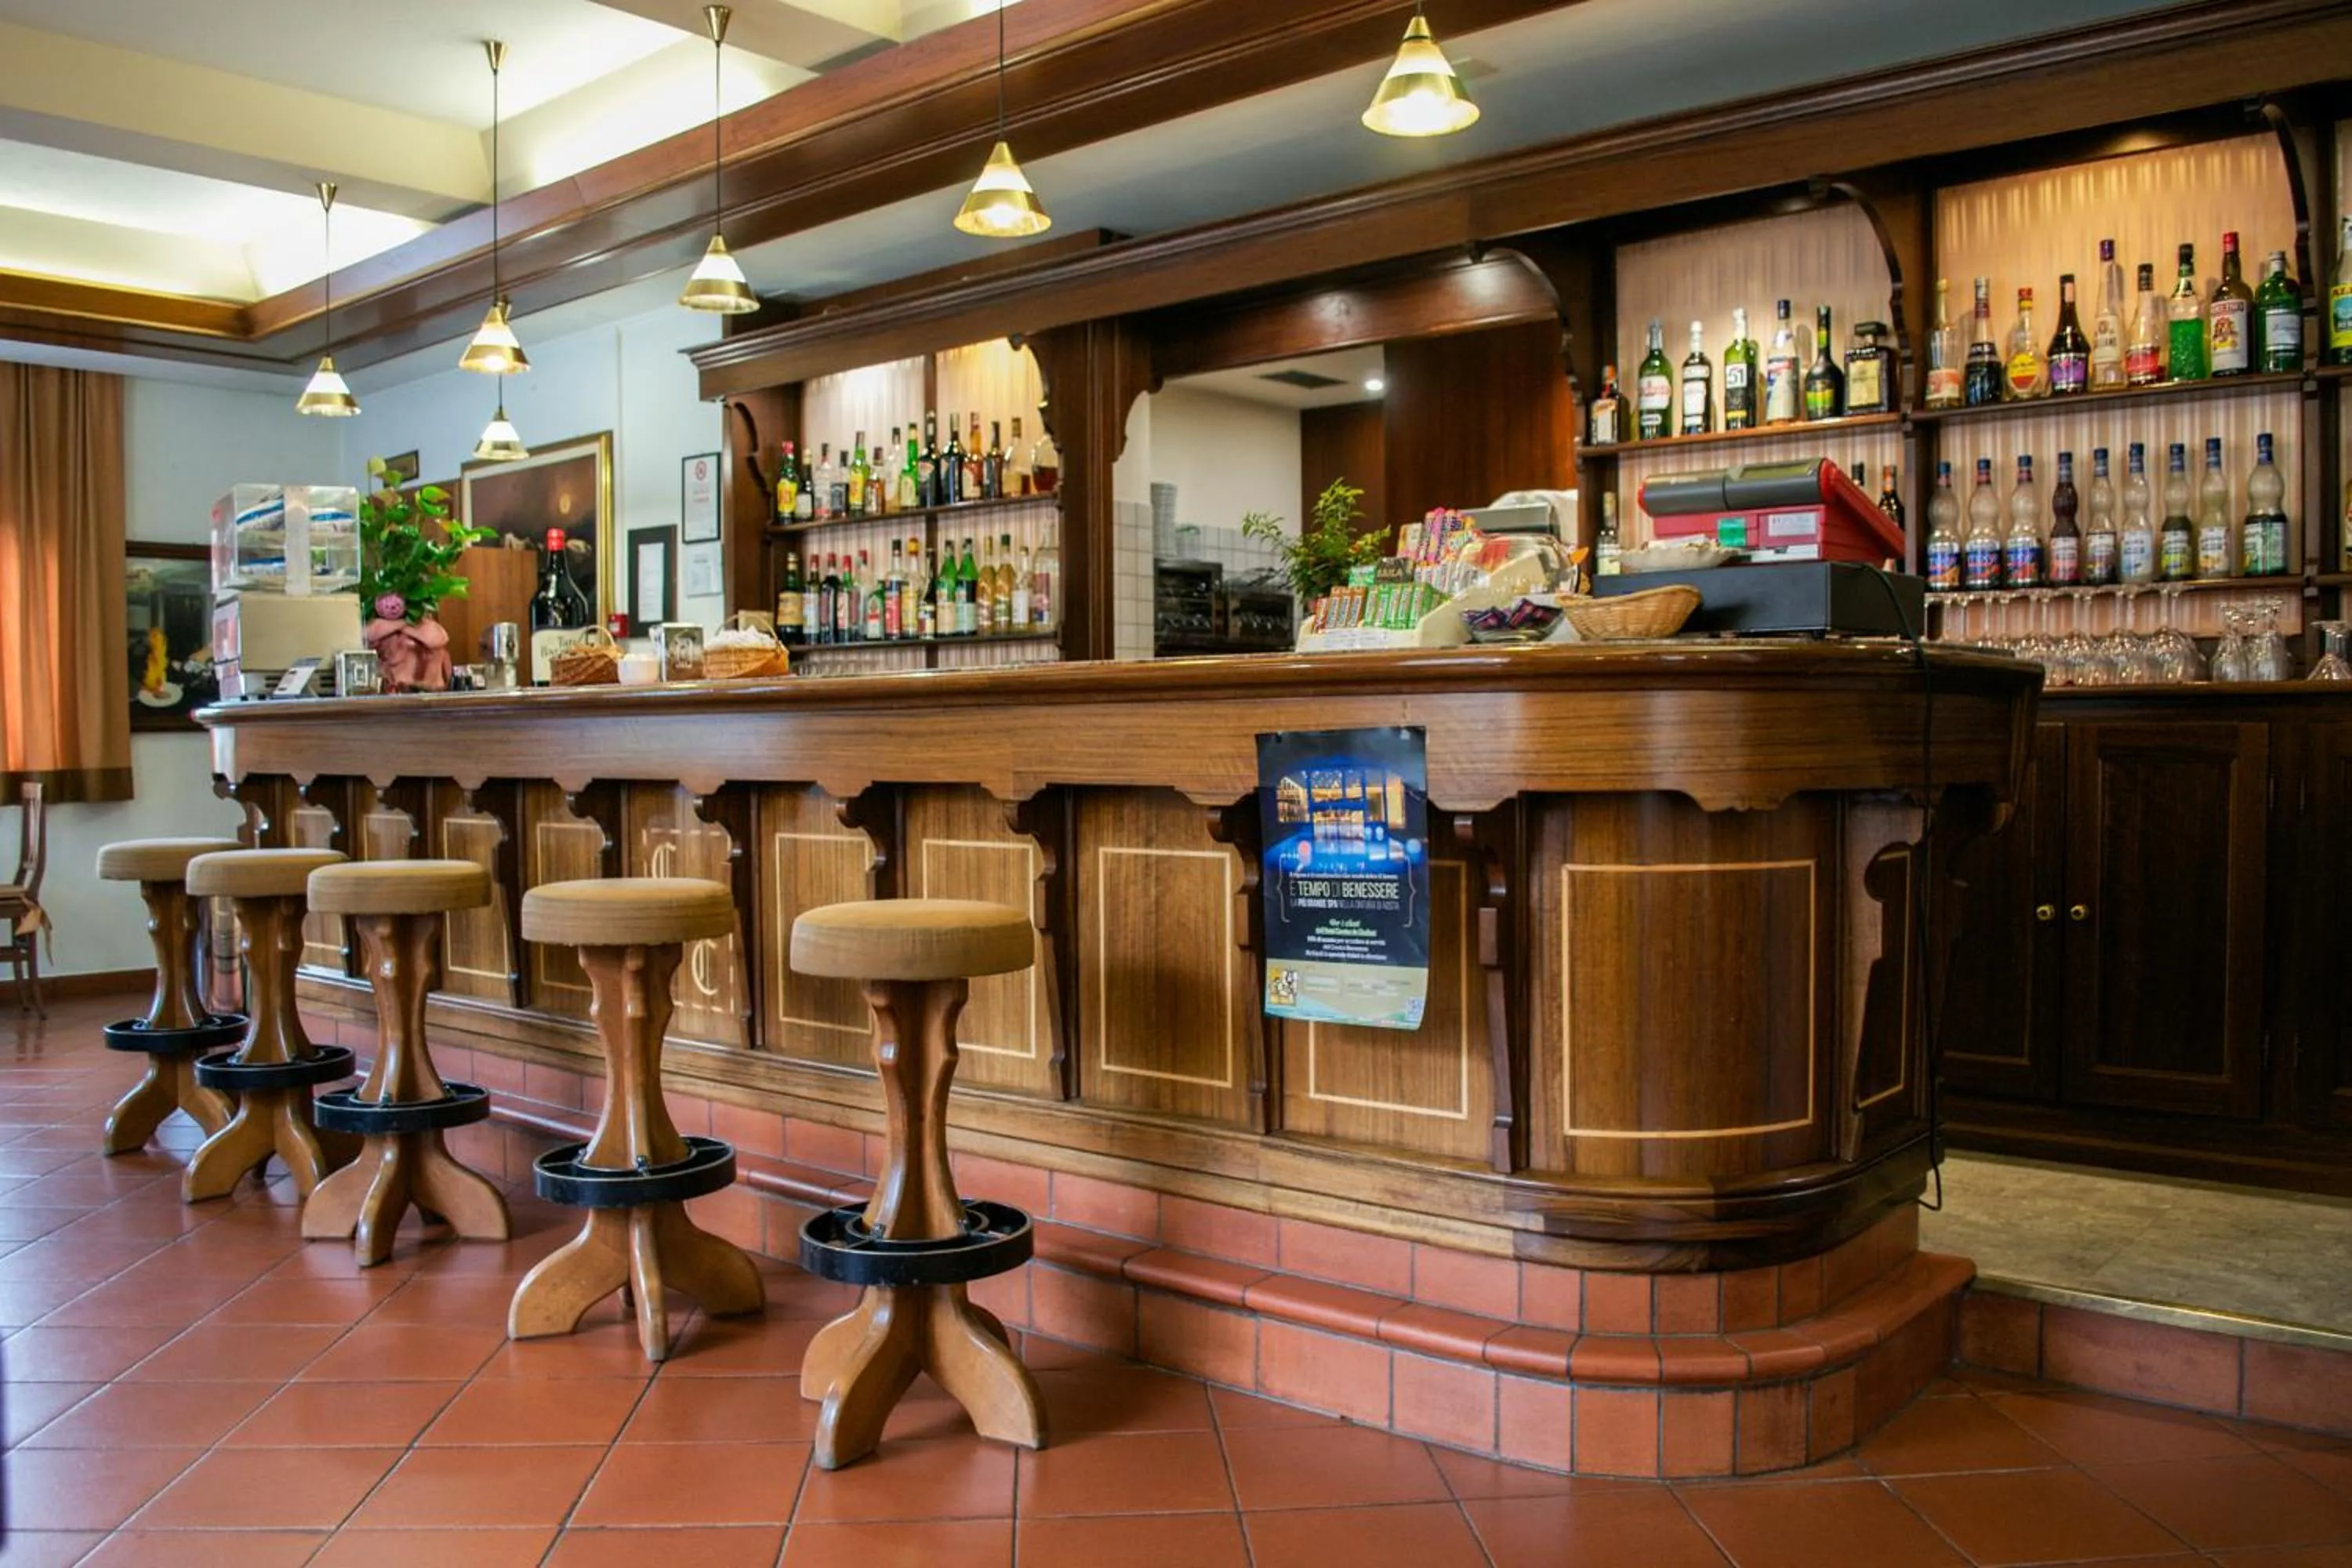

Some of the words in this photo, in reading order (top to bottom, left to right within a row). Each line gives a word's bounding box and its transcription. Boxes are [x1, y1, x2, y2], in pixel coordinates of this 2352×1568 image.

[1727, 366, 1744, 386] 51
[1298, 880, 1330, 897] TEMPO
[1341, 881, 1399, 899] BENESSERE
